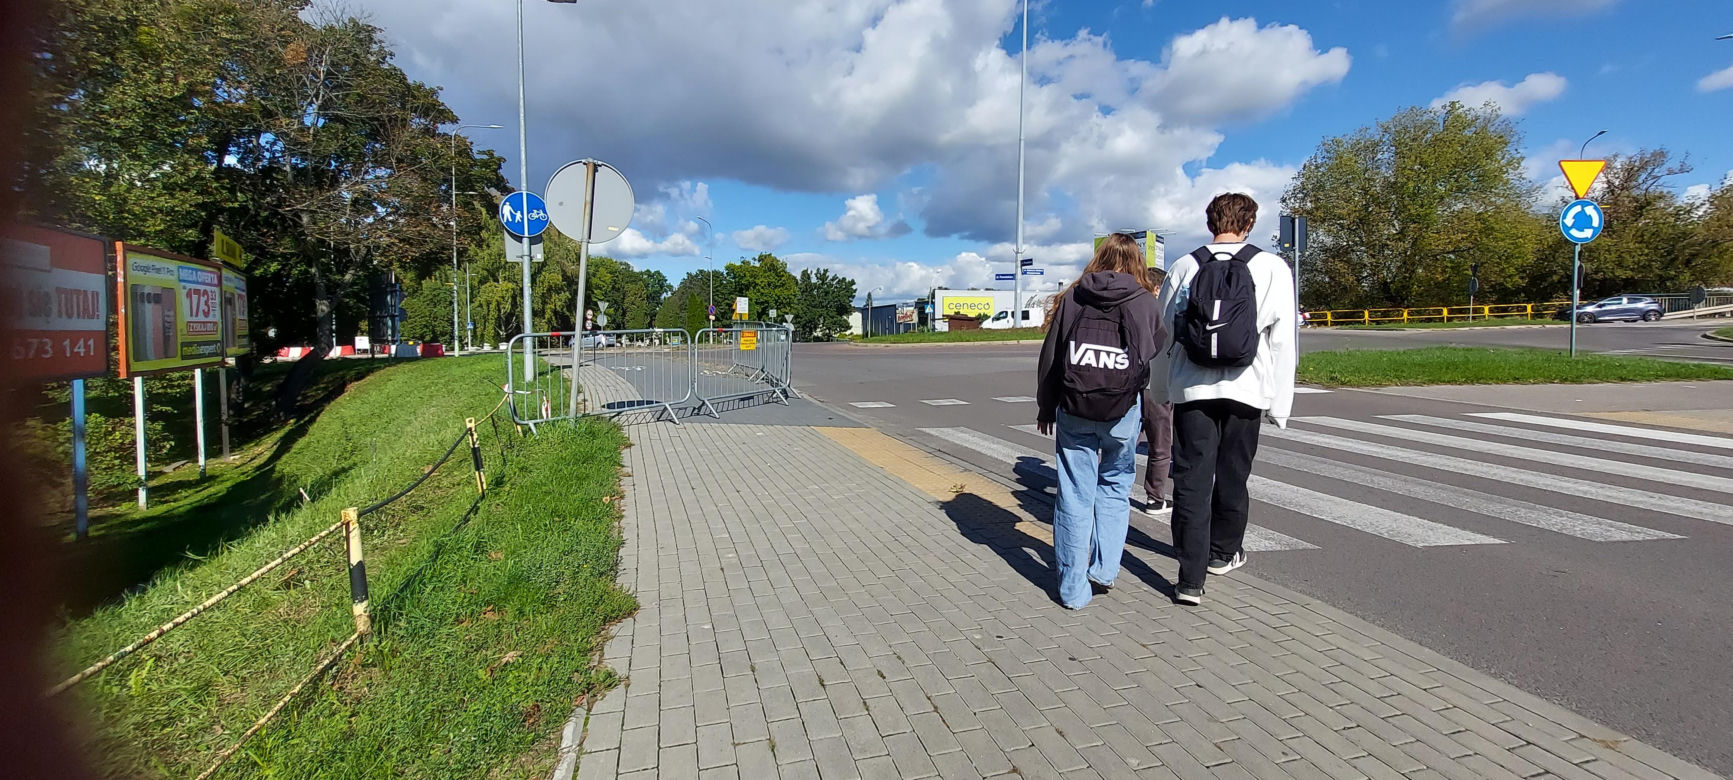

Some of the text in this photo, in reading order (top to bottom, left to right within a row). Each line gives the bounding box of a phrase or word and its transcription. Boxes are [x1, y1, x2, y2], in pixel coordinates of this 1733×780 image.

[131, 261, 151, 275] Google
[179, 268, 197, 283] MEGA
[197, 271, 218, 285] OFERTA
[56, 286, 100, 320] TUTAJ!
[186, 287, 211, 318] 173
[947, 301, 991, 311] ceneco
[62, 337, 95, 358] 141
[1069, 340, 1130, 370] VANS
